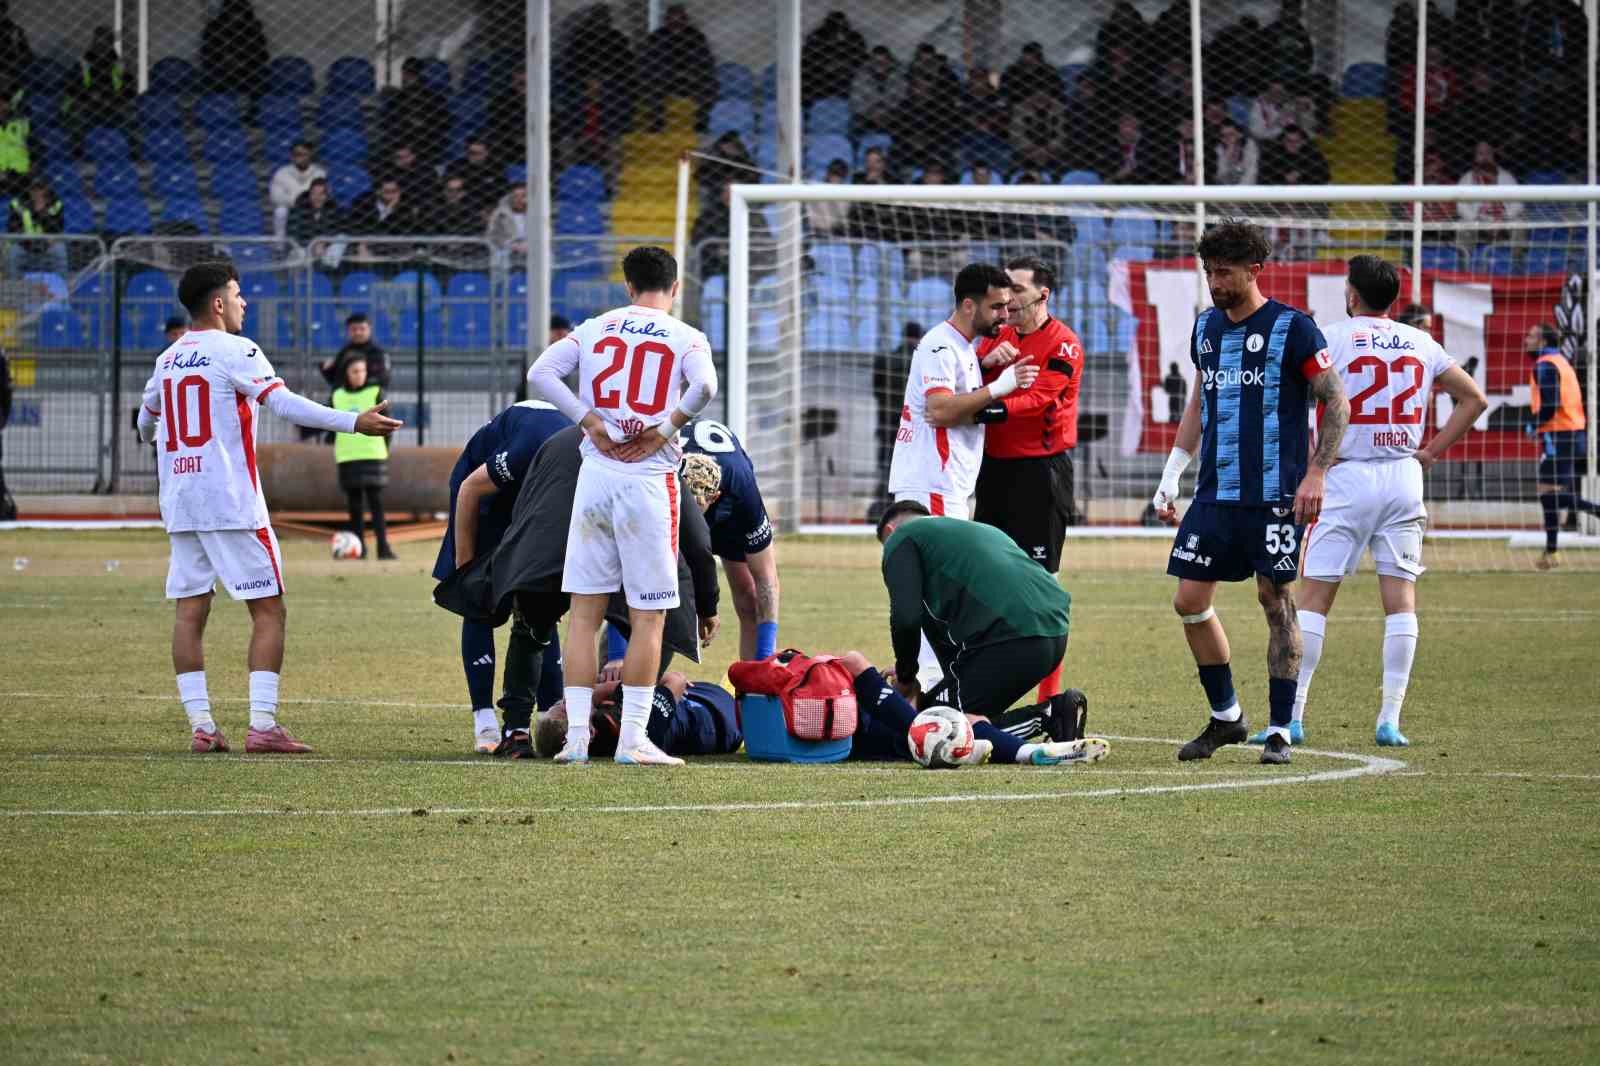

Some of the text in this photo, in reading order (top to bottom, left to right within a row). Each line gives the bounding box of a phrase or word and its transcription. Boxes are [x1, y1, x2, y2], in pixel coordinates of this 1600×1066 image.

[620, 319, 670, 338] Kula
[1371, 332, 1416, 350] Kula
[170, 351, 211, 370] Kula
[591, 336, 675, 416] 20
[1347, 355, 1425, 425] 22
[162, 374, 213, 453] 10
[1264, 523, 1297, 555] 53
